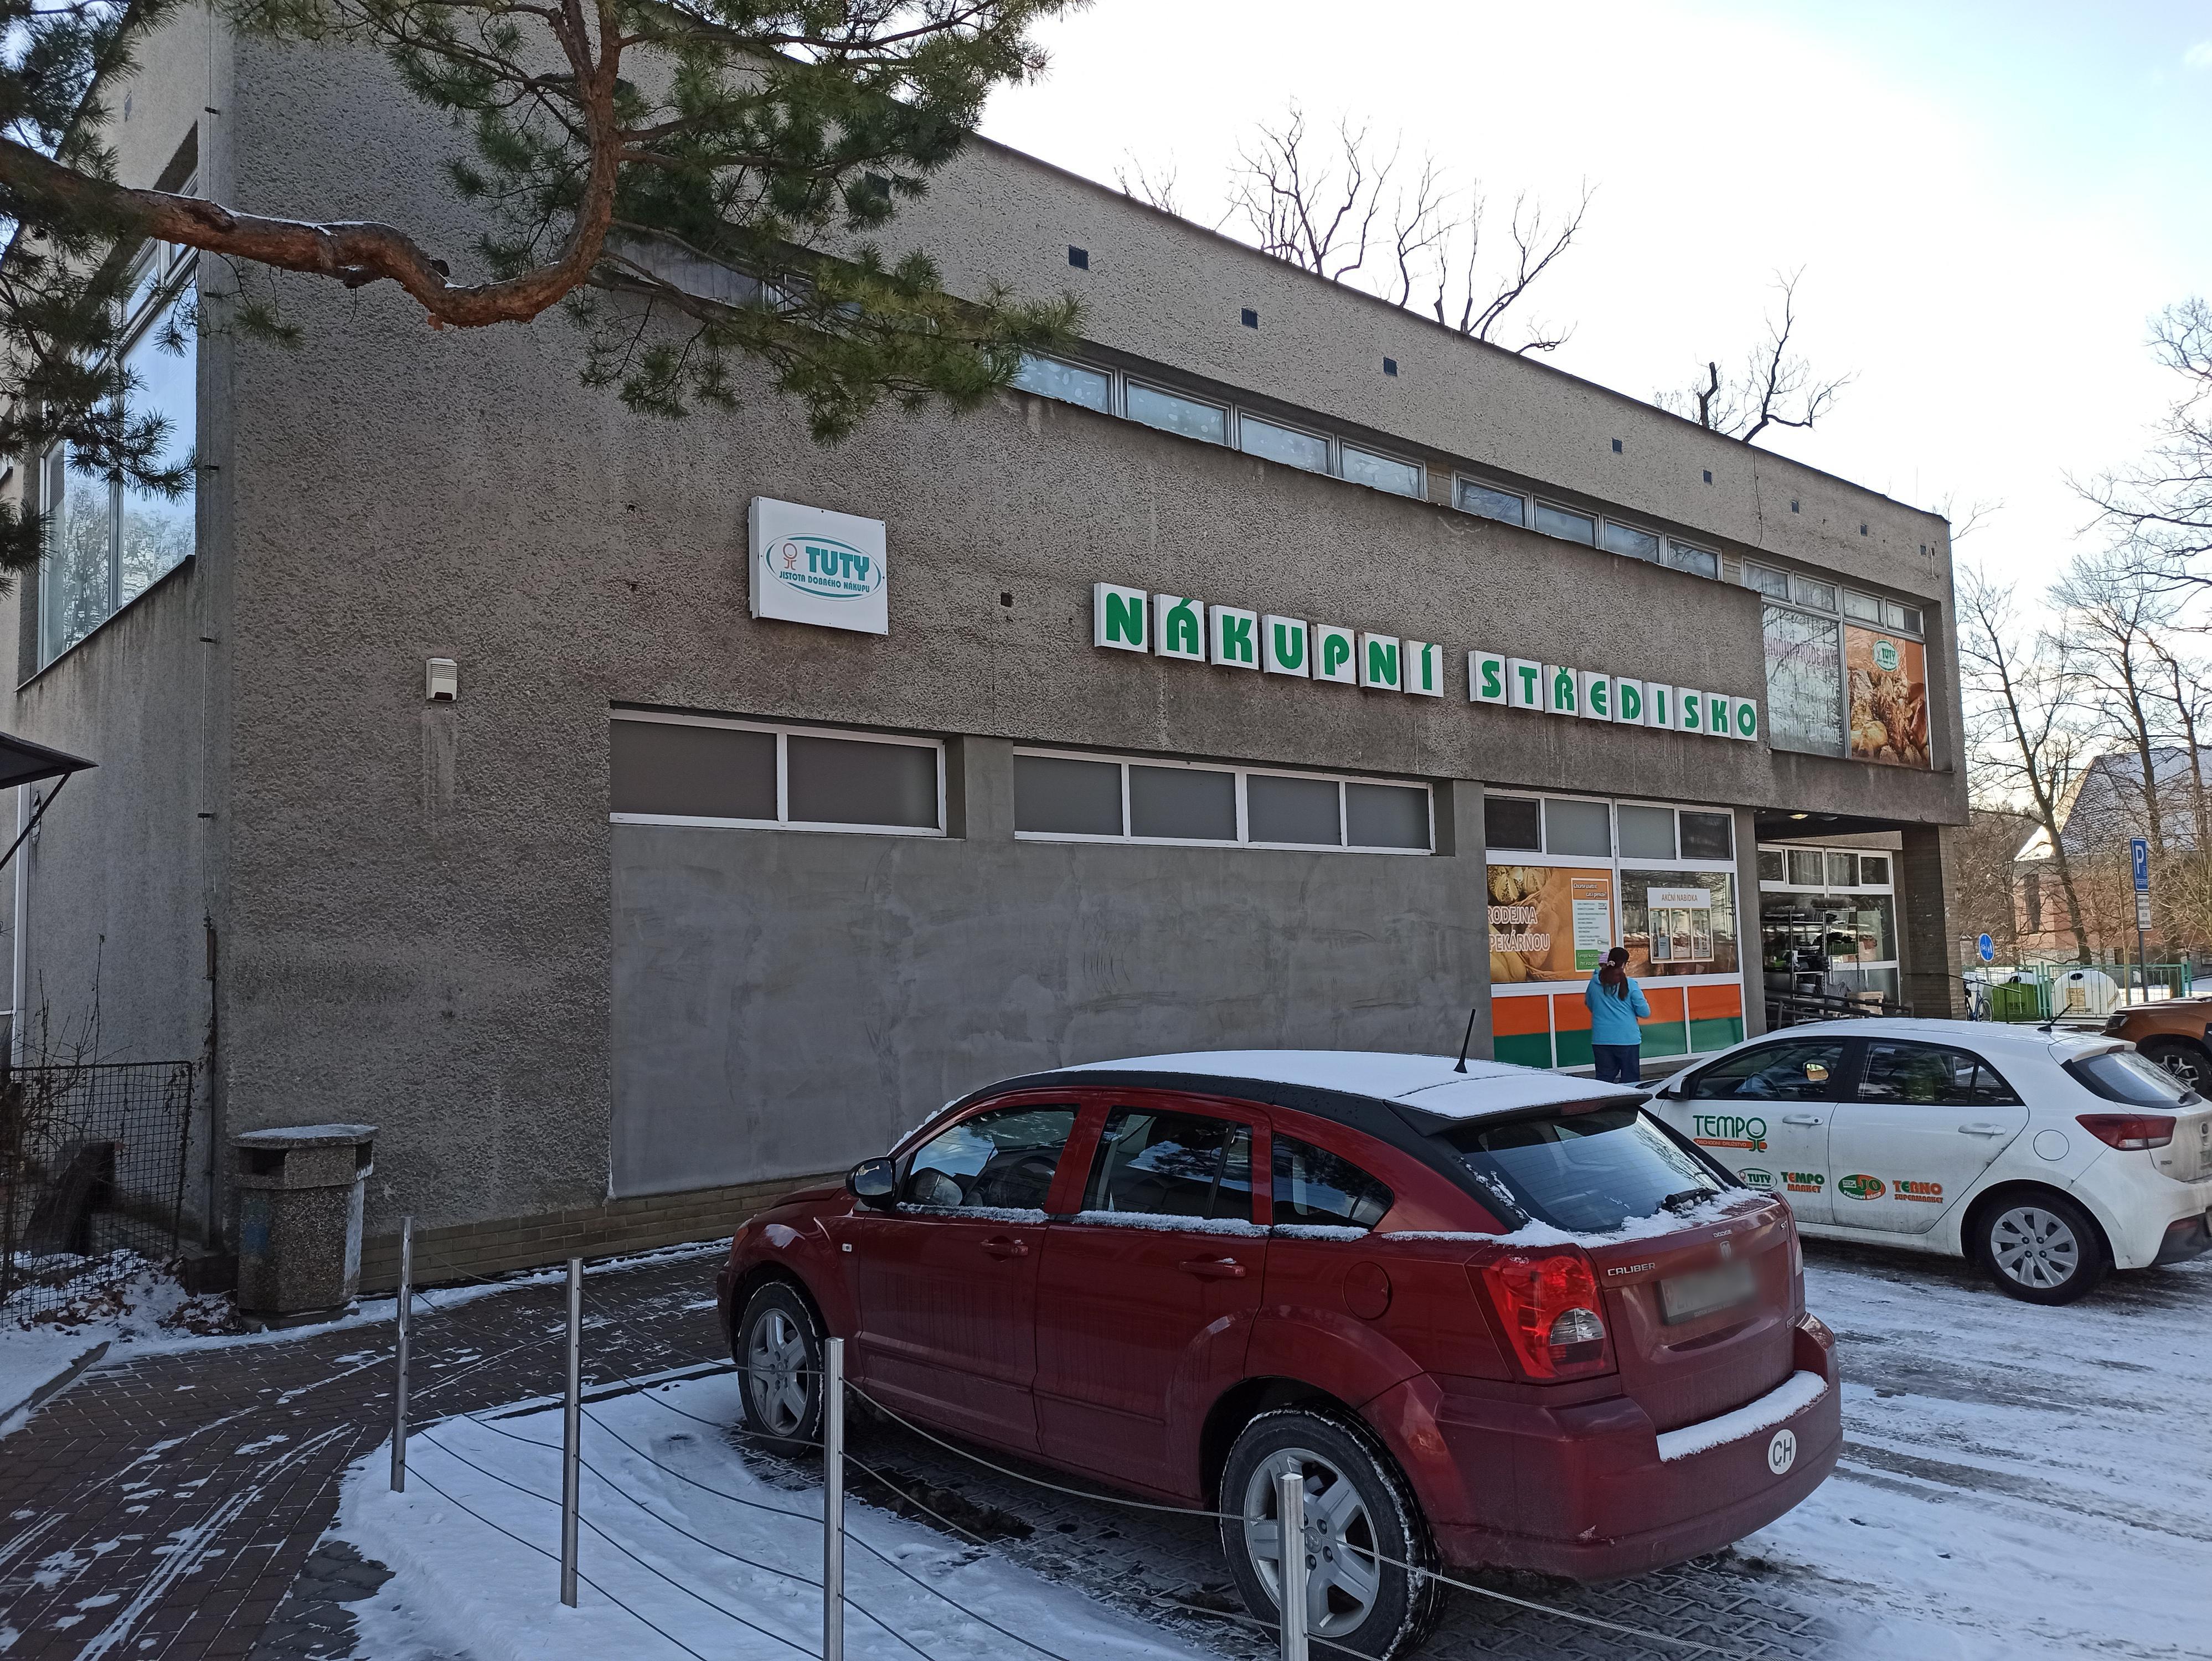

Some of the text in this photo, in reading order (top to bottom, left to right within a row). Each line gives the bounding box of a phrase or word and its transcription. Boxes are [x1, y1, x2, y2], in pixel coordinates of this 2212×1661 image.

[806, 546, 869, 581] TUTY
[779, 571, 870, 593] JISTOTA DOBRÉHO NÁKUPU
[1881, 647, 1895, 661] TUTY
[1106, 592, 1756, 736] NÁKUPNÍ STŘEDISKO
[2135, 845, 2144, 875] P
[1662, 892, 1698, 901] AKČNÍ NABÍDKA
[1489, 930, 1550, 952] PEKÁRNOU
[1693, 1115, 1767, 1139] TEMPO
[1747, 1173, 1771, 1184] TUTY
[1781, 1172, 1825, 1185] TEMPO
[1857, 1178, 1883, 1191] JO
[1787, 1183, 1822, 1193] MARKET
[1892, 1180, 1943, 1196] TERNO
[1894, 1194, 1943, 1204] SUPERMARKET
[1713, 1229, 1733, 1238] DODGE
[1607, 1262, 1656, 1276] CALIBER
[1773, 1437, 1792, 1467] CH
